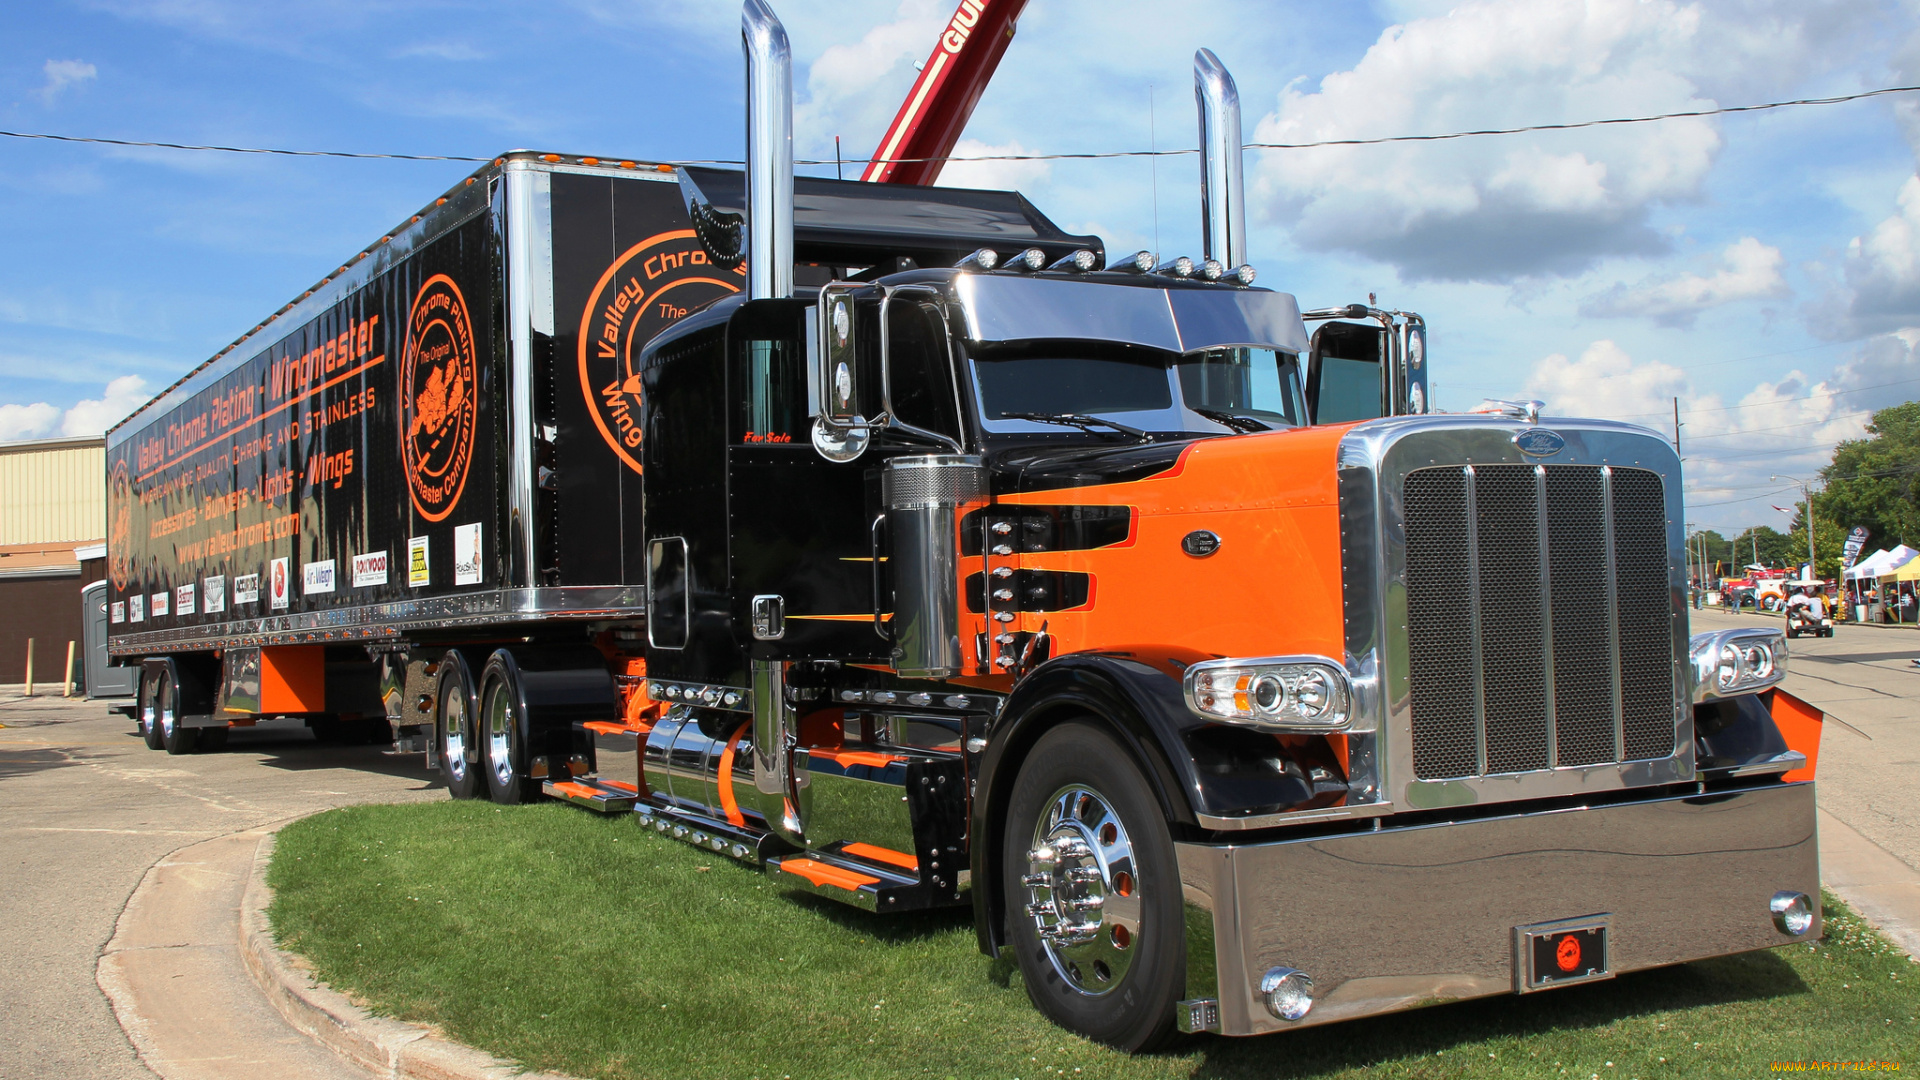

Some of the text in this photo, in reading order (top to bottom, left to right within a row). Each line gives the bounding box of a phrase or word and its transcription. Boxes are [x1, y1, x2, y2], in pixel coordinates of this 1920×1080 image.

[415, 293, 450, 333] Chrome
[450, 301, 471, 382] Plating
[598, 250, 747, 358] Valley Chro
[659, 303, 687, 319] The
[138, 437, 165, 472] Valley
[168, 412, 207, 457] Chrome
[211, 386, 254, 434] Plating
[271, 314, 379, 402] Wingmaster
[420, 340, 450, 365] The Original
[196, 454, 229, 482] QUALITY
[232, 432, 272, 466] CHROME
[277, 421, 300, 447] AND
[304, 387, 375, 435] STAINLESS
[444, 396, 473, 495] Company
[601, 380, 643, 448] Wing
[744, 431, 791, 443] For Sale
[150, 507, 197, 540] Accessories
[205, 487, 248, 521] Bumpers
[258, 467, 294, 510] Lights
[309, 448, 353, 490] Wings
[179, 512, 300, 565] www.valleychrome.com
